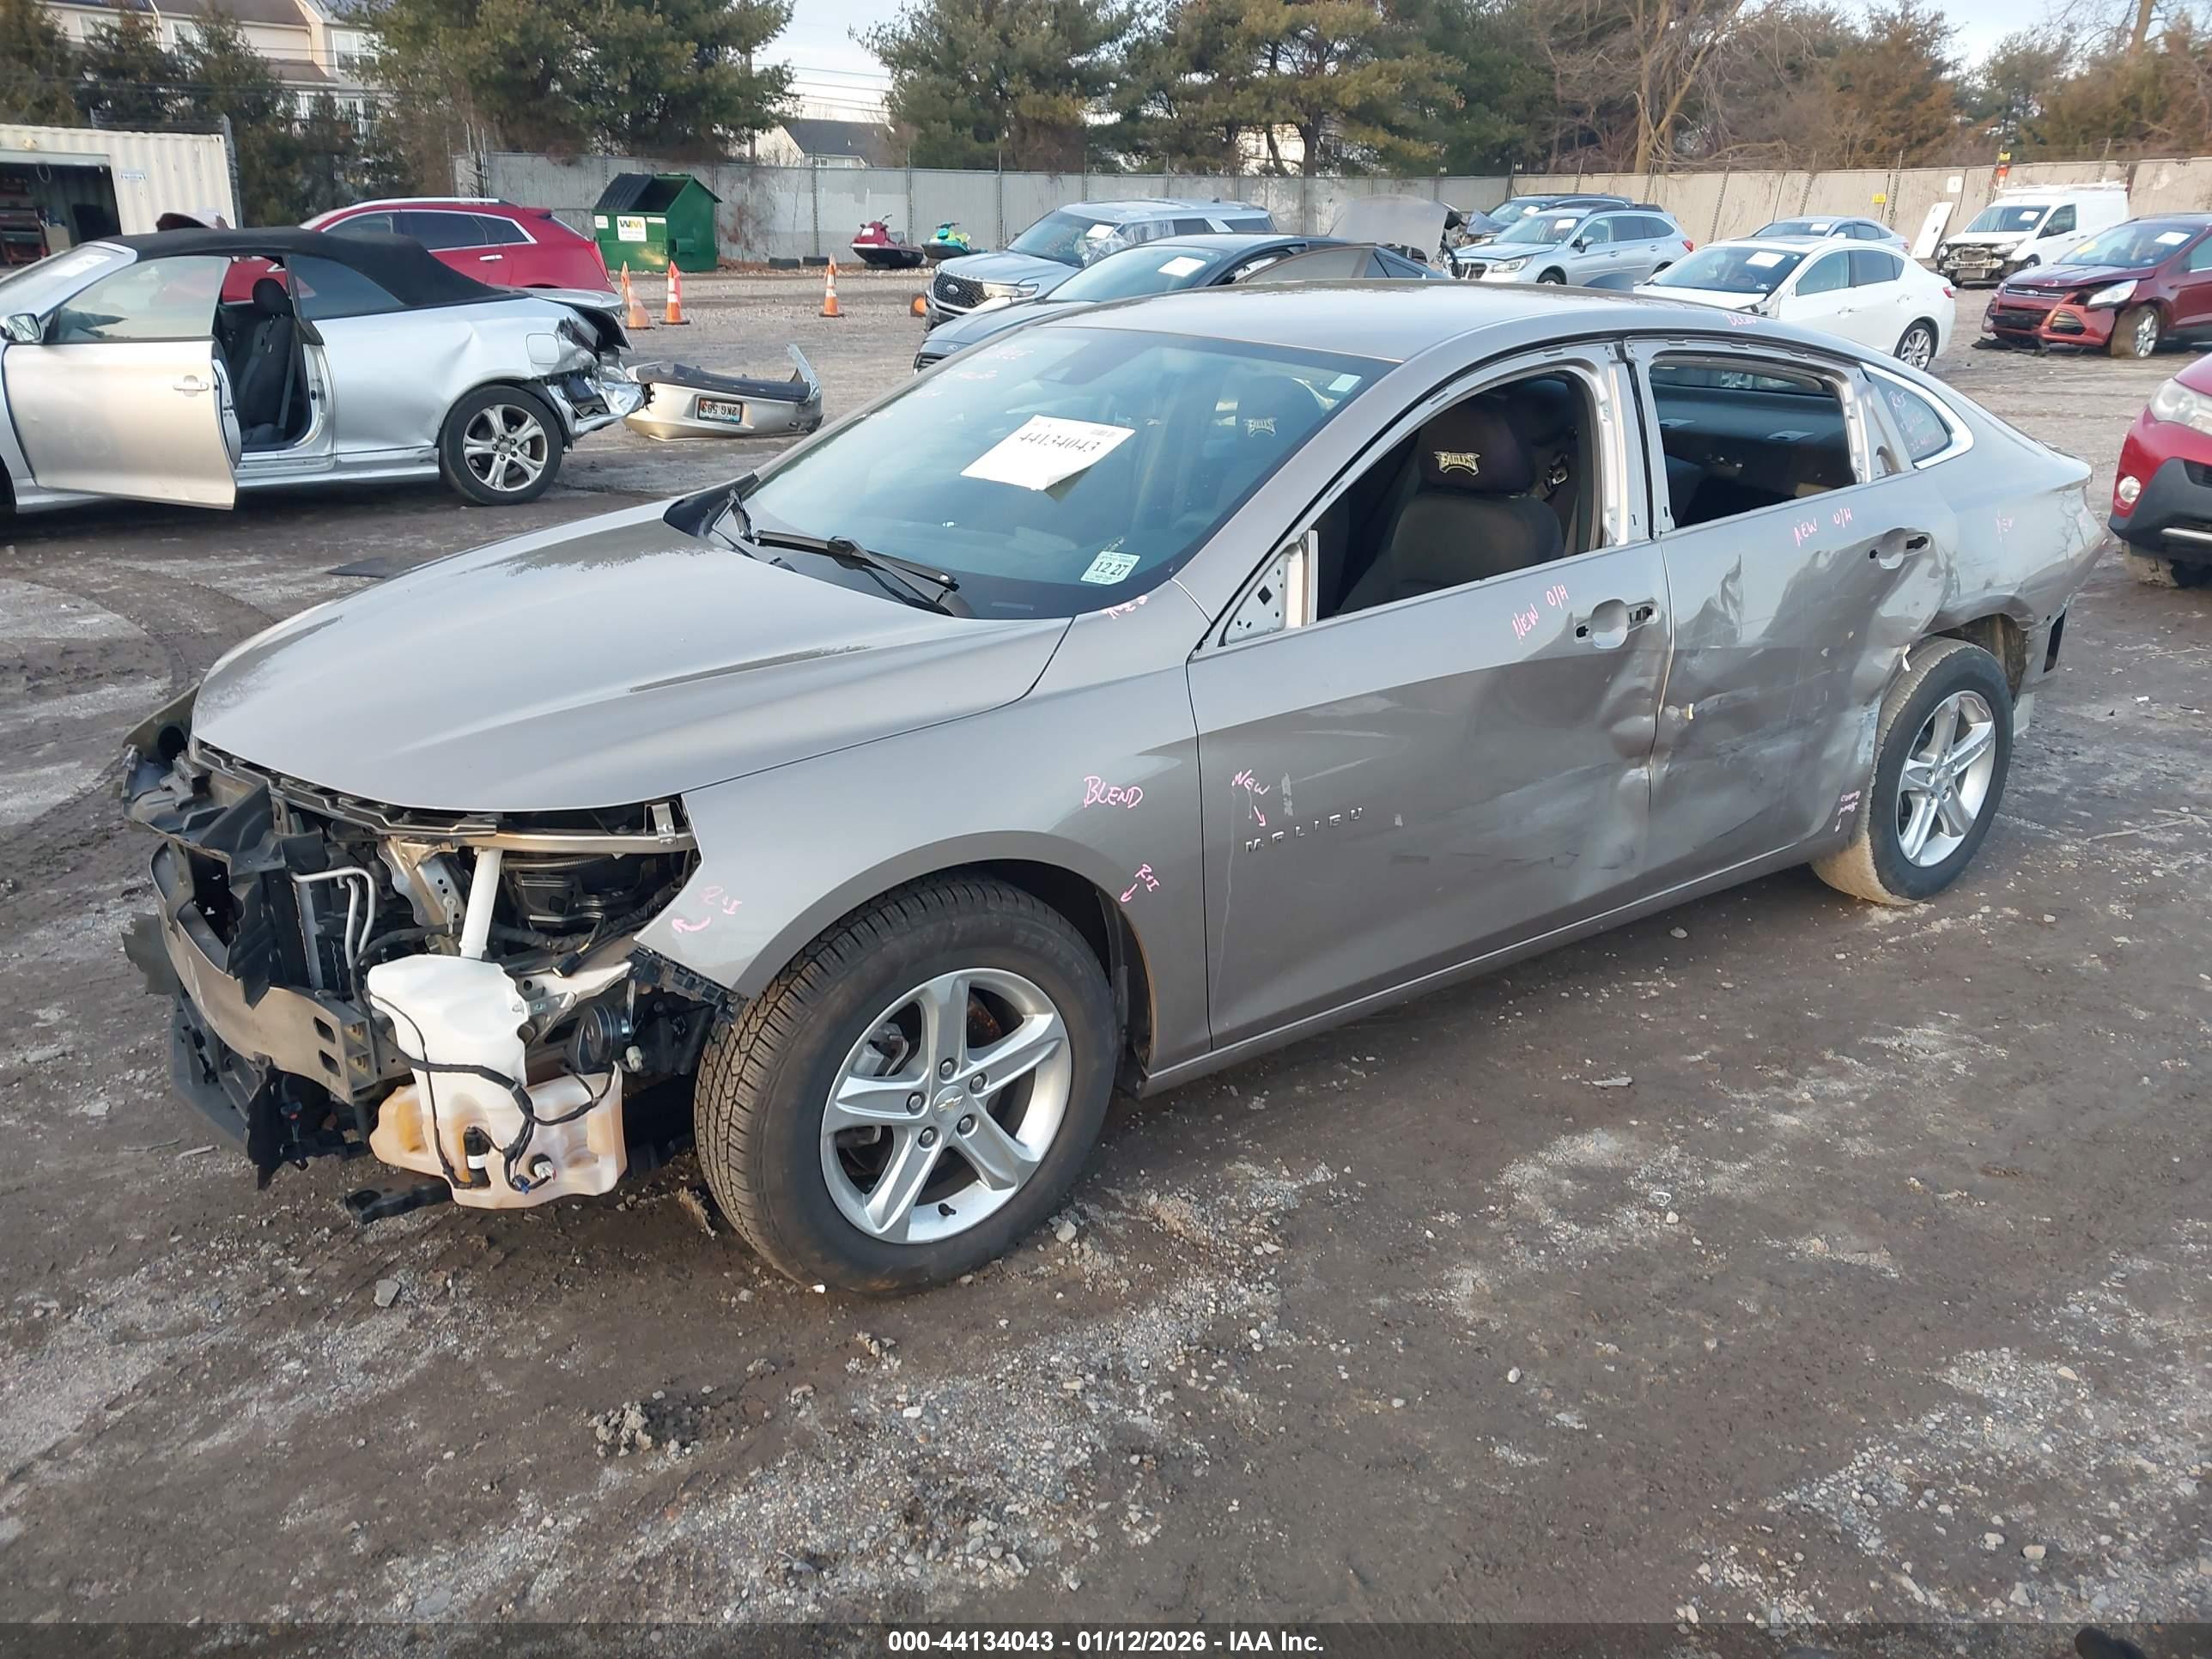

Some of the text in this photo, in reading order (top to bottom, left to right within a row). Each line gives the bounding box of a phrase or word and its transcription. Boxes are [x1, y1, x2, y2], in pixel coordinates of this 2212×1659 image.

[619, 220, 642, 228] WM
[1435, 452, 1479, 473] EAGLES
[1093, 561, 1129, 577] 12 27
[1511, 584, 1570, 640] NEW O/H
[1084, 775, 1144, 808] BLEND
[1231, 769, 1270, 795] NEW
[1244, 807, 1364, 854] MALIBU
